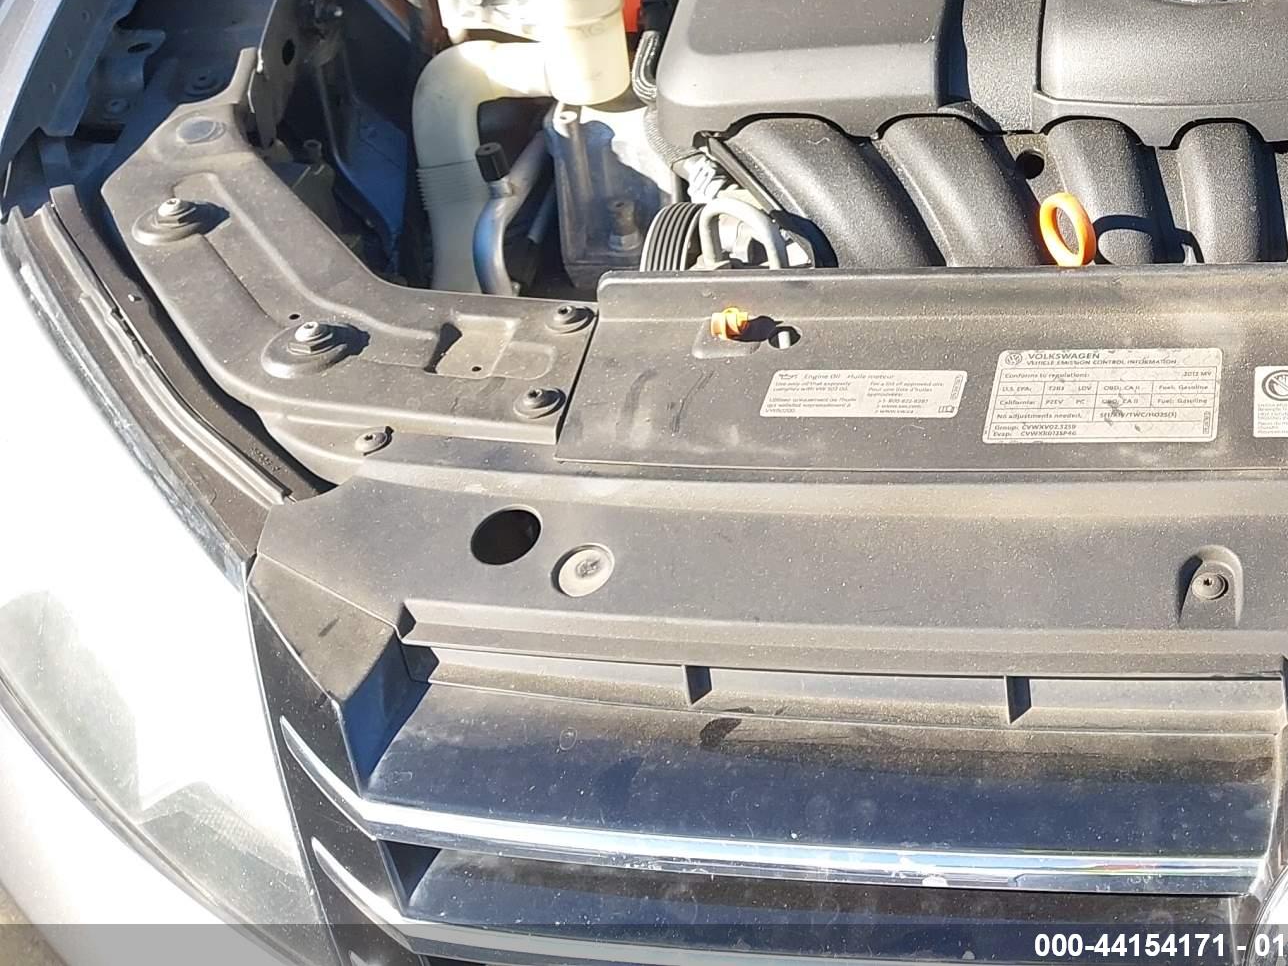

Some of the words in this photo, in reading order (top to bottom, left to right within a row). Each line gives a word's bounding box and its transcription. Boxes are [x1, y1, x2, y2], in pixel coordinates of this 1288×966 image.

[1027, 353, 1100, 361] VOLKSWAGEN
[803, 373, 828, 381] Engine
[1008, 412, 1053, 422] adjustments
